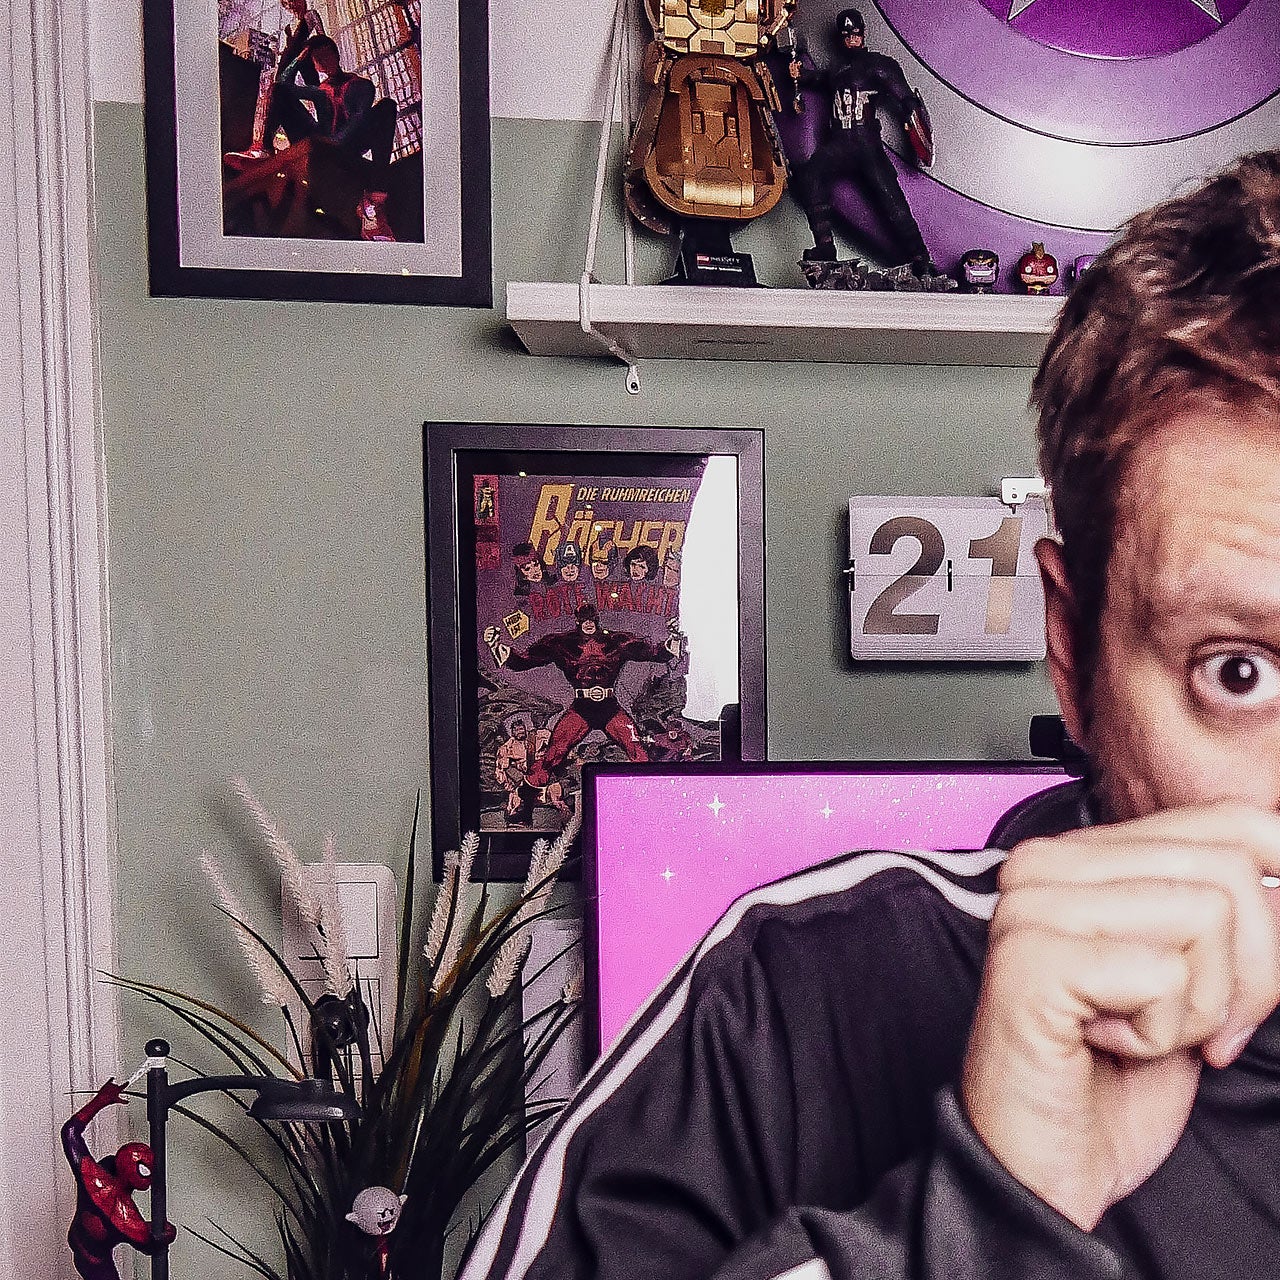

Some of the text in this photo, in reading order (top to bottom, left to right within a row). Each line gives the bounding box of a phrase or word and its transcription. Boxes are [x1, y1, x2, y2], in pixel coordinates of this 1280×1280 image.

[577, 487, 692, 503] DIE RUHMREICHEN
[862, 515, 1024, 635] 21
